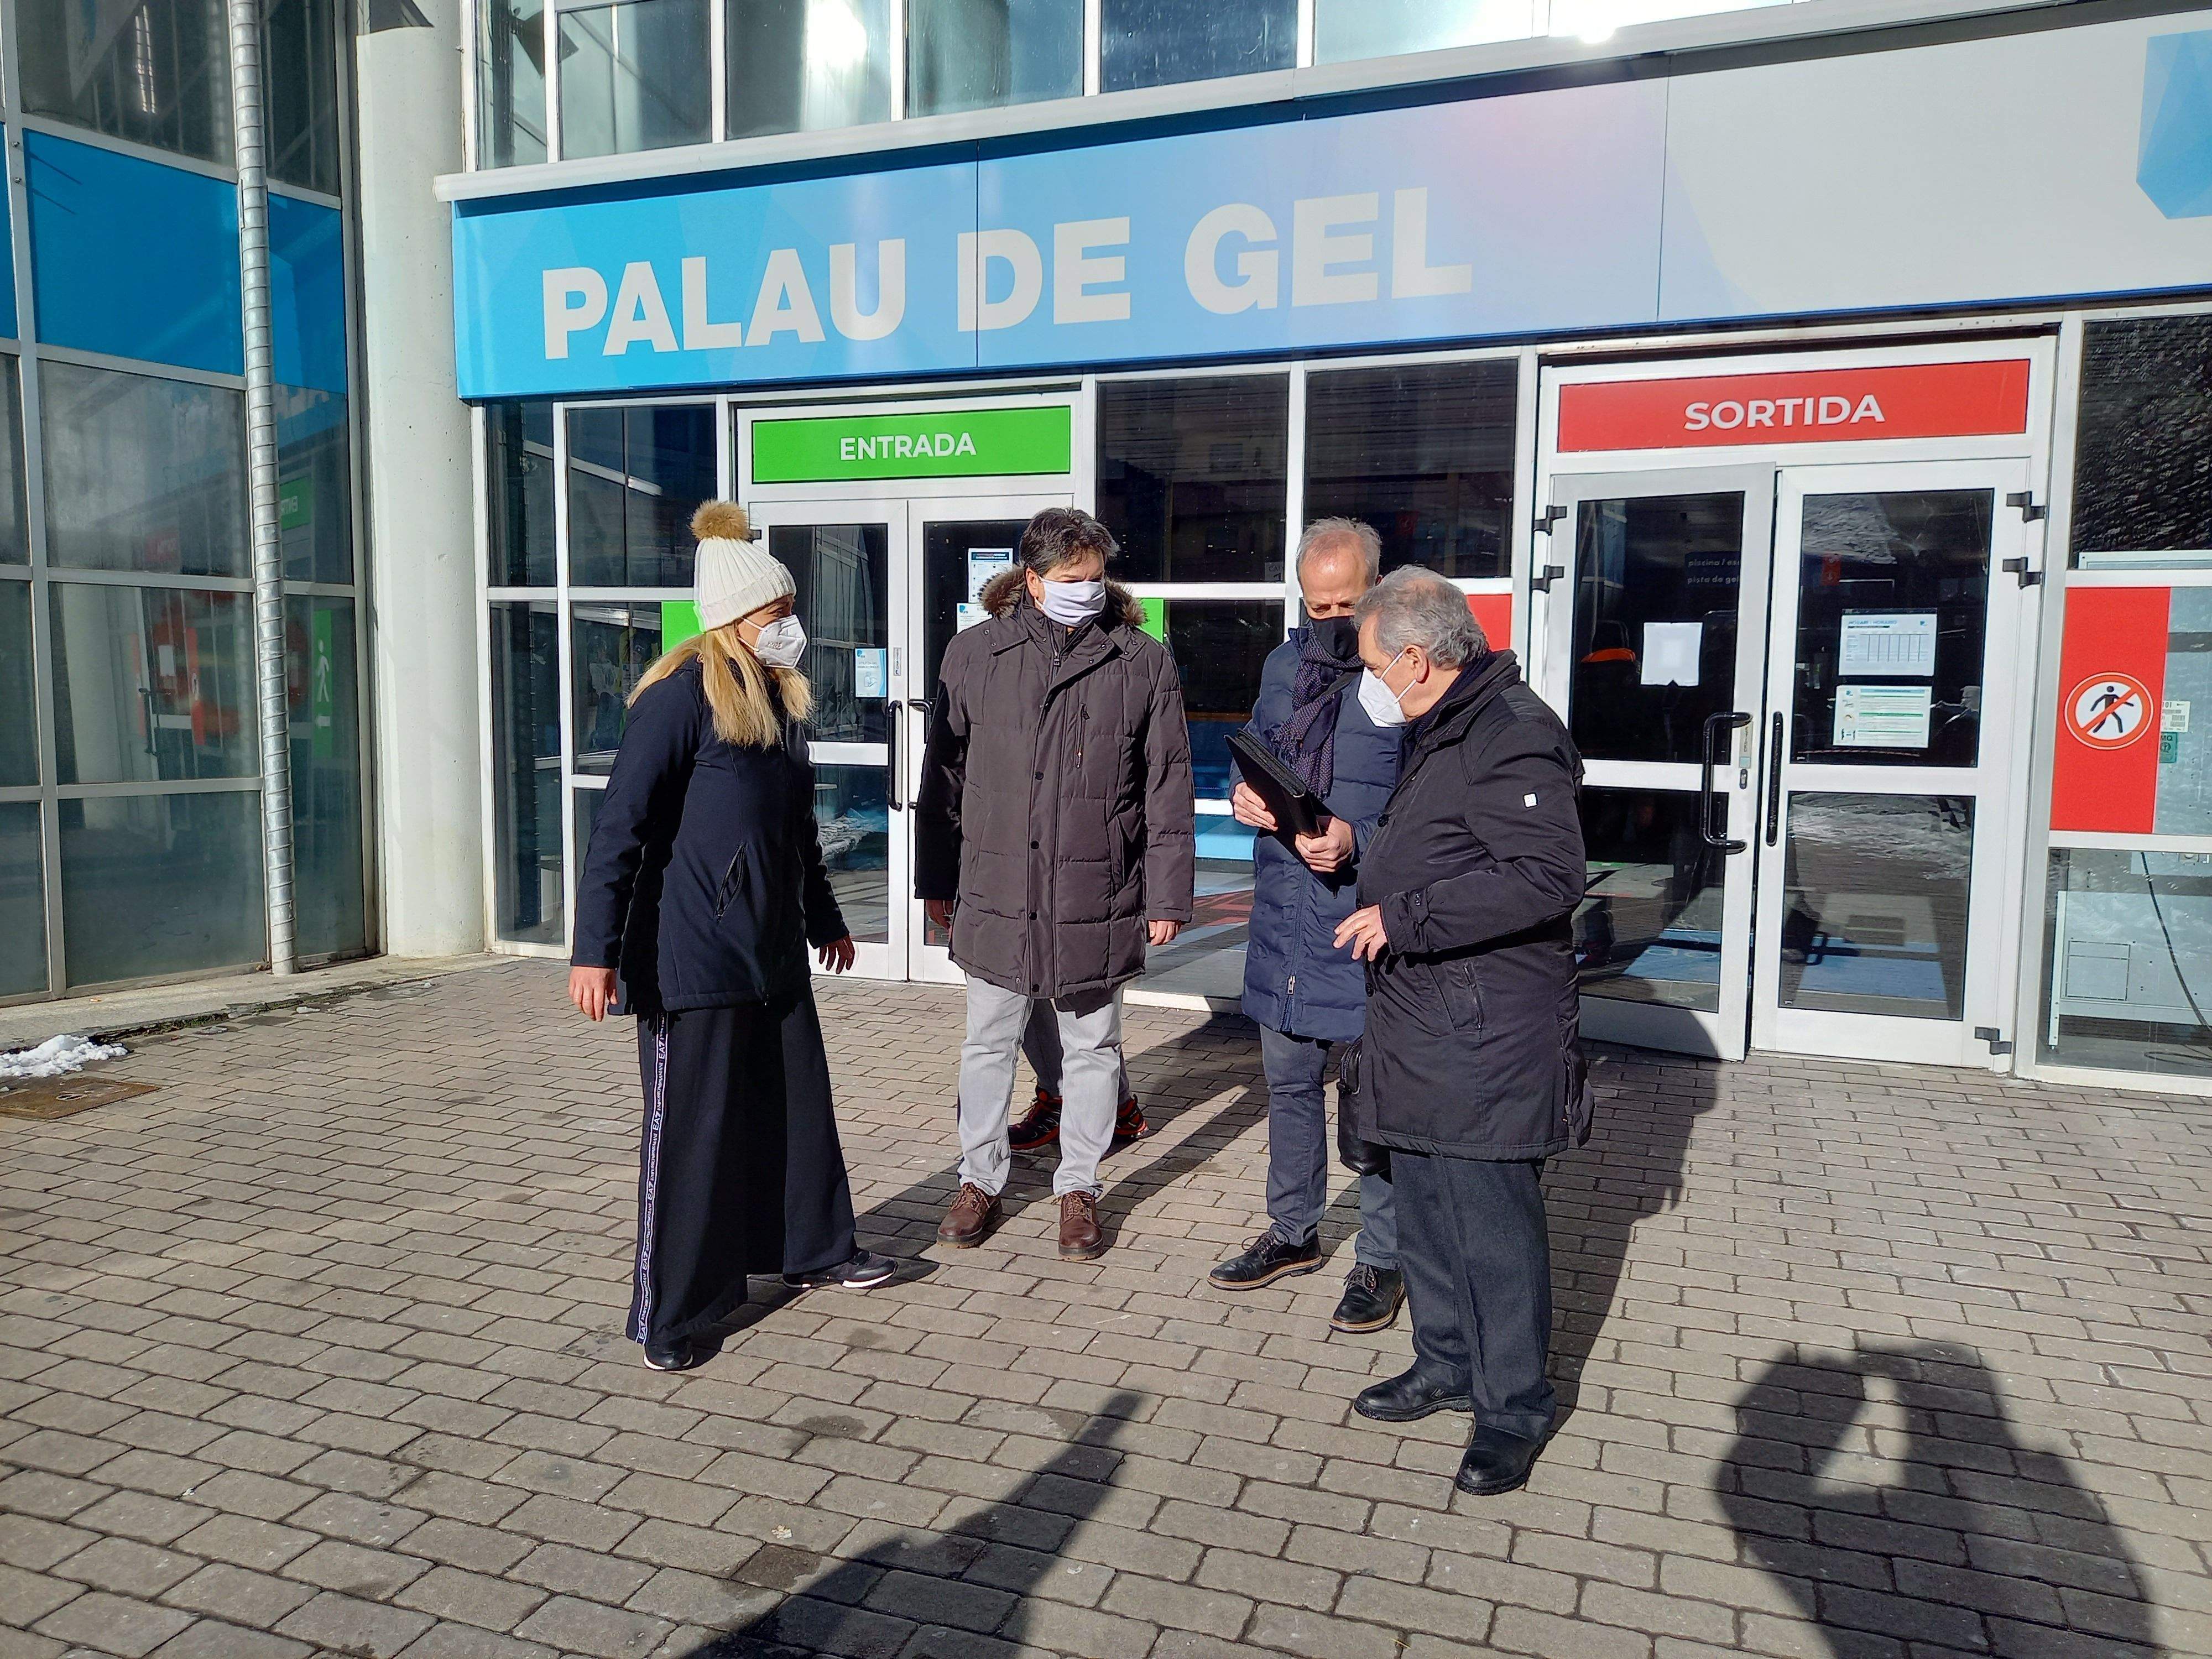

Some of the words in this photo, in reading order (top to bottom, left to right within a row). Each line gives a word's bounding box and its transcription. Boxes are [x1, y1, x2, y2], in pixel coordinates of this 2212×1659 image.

[543, 238, 906, 359] PALAU
[958, 217, 1131, 331] DE
[1185, 187, 1473, 314] GEL
[1684, 395, 1885, 431] SORTIDA
[840, 433, 977, 460] ENTRADA
[1687, 576, 1710, 585] pista
[653, 1110, 661, 1131] EA7
